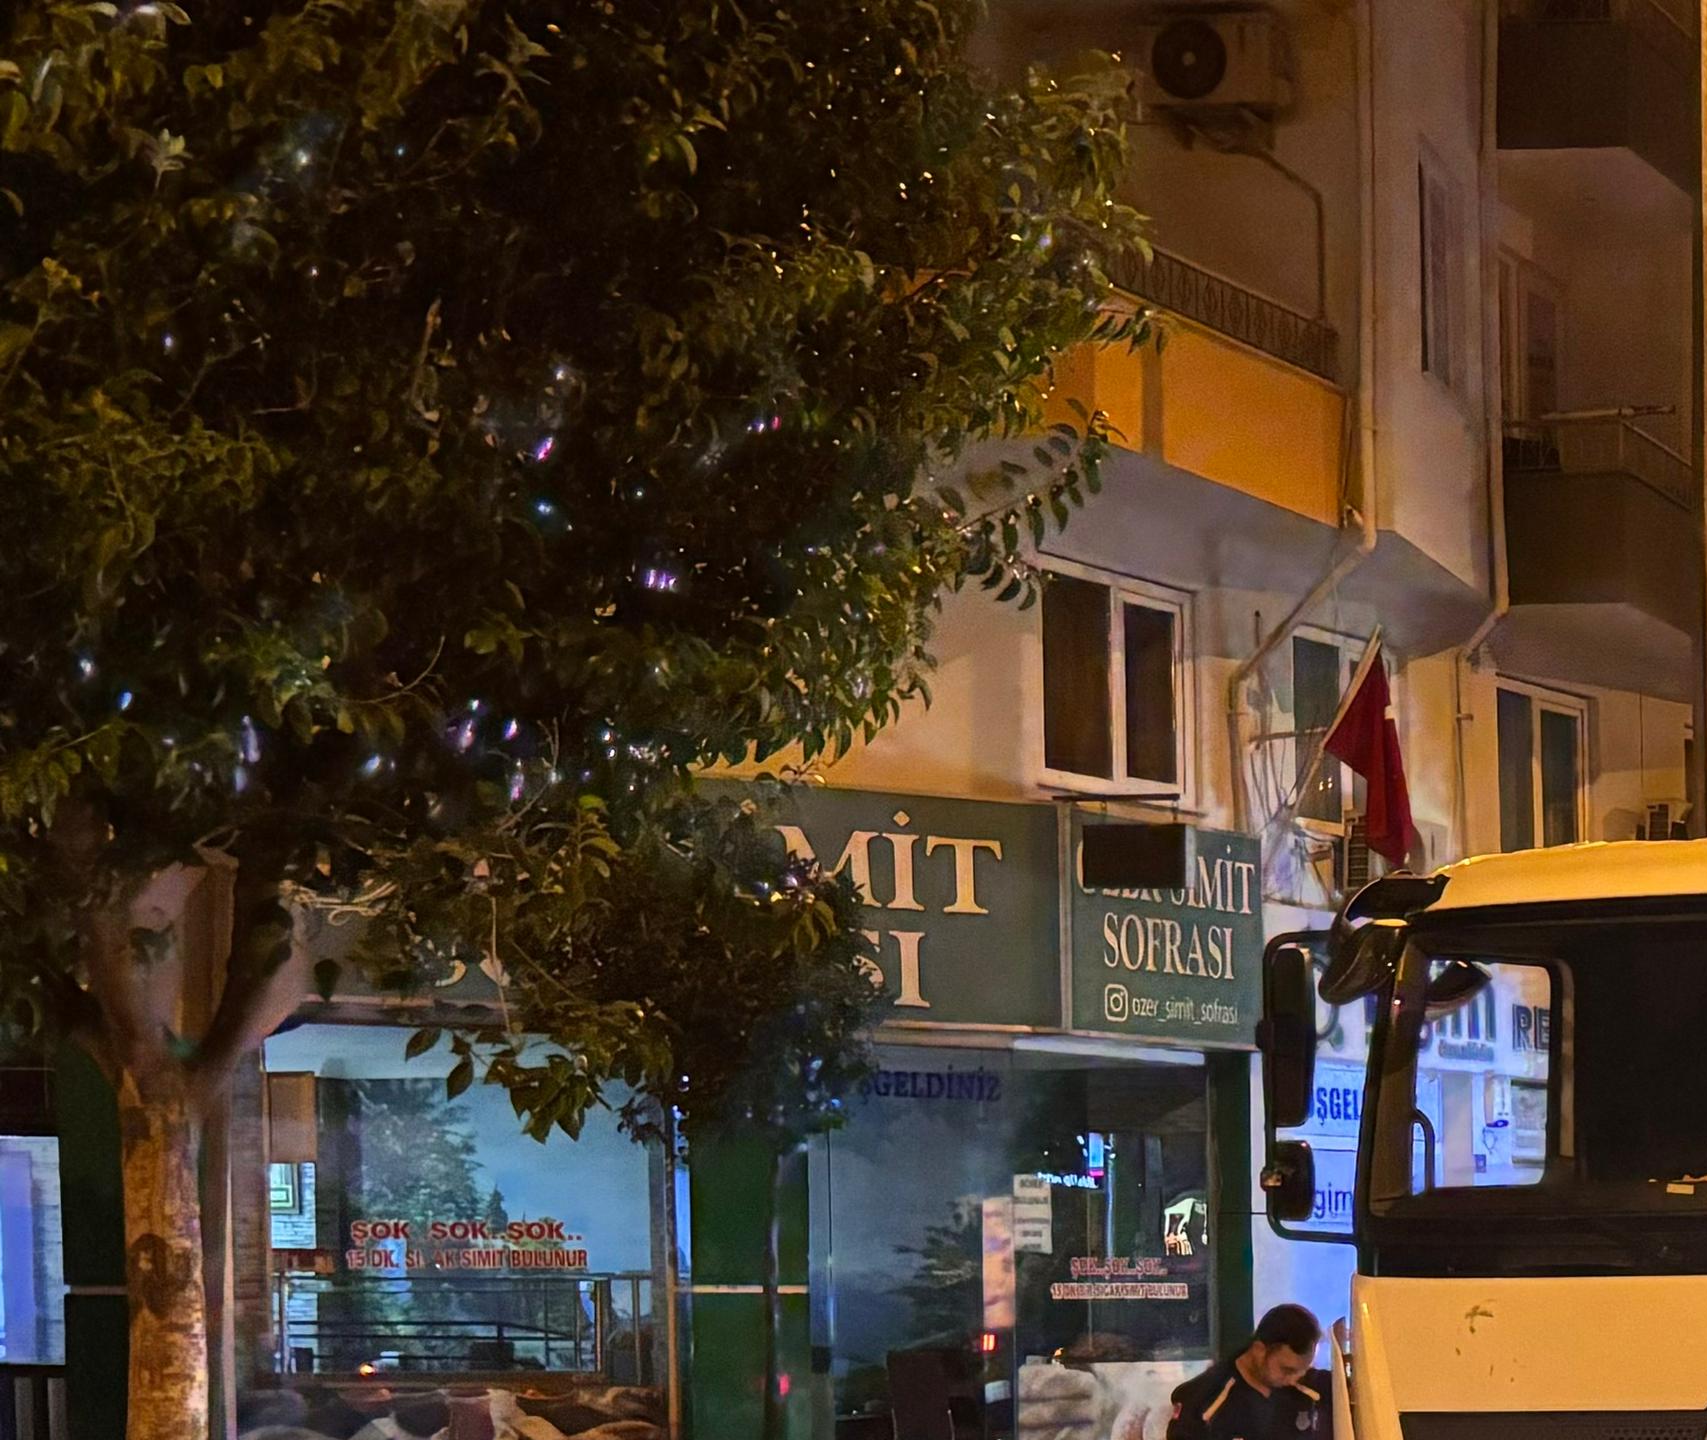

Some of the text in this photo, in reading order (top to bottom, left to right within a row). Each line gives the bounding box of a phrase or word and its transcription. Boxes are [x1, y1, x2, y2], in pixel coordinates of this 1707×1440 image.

[775, 810, 1003, 915] MİT
[1103, 911, 1236, 980] SOFRASI
[405, 1250, 455, 1269] SIAK
[510, 1250, 589, 1269] BULUNUR
